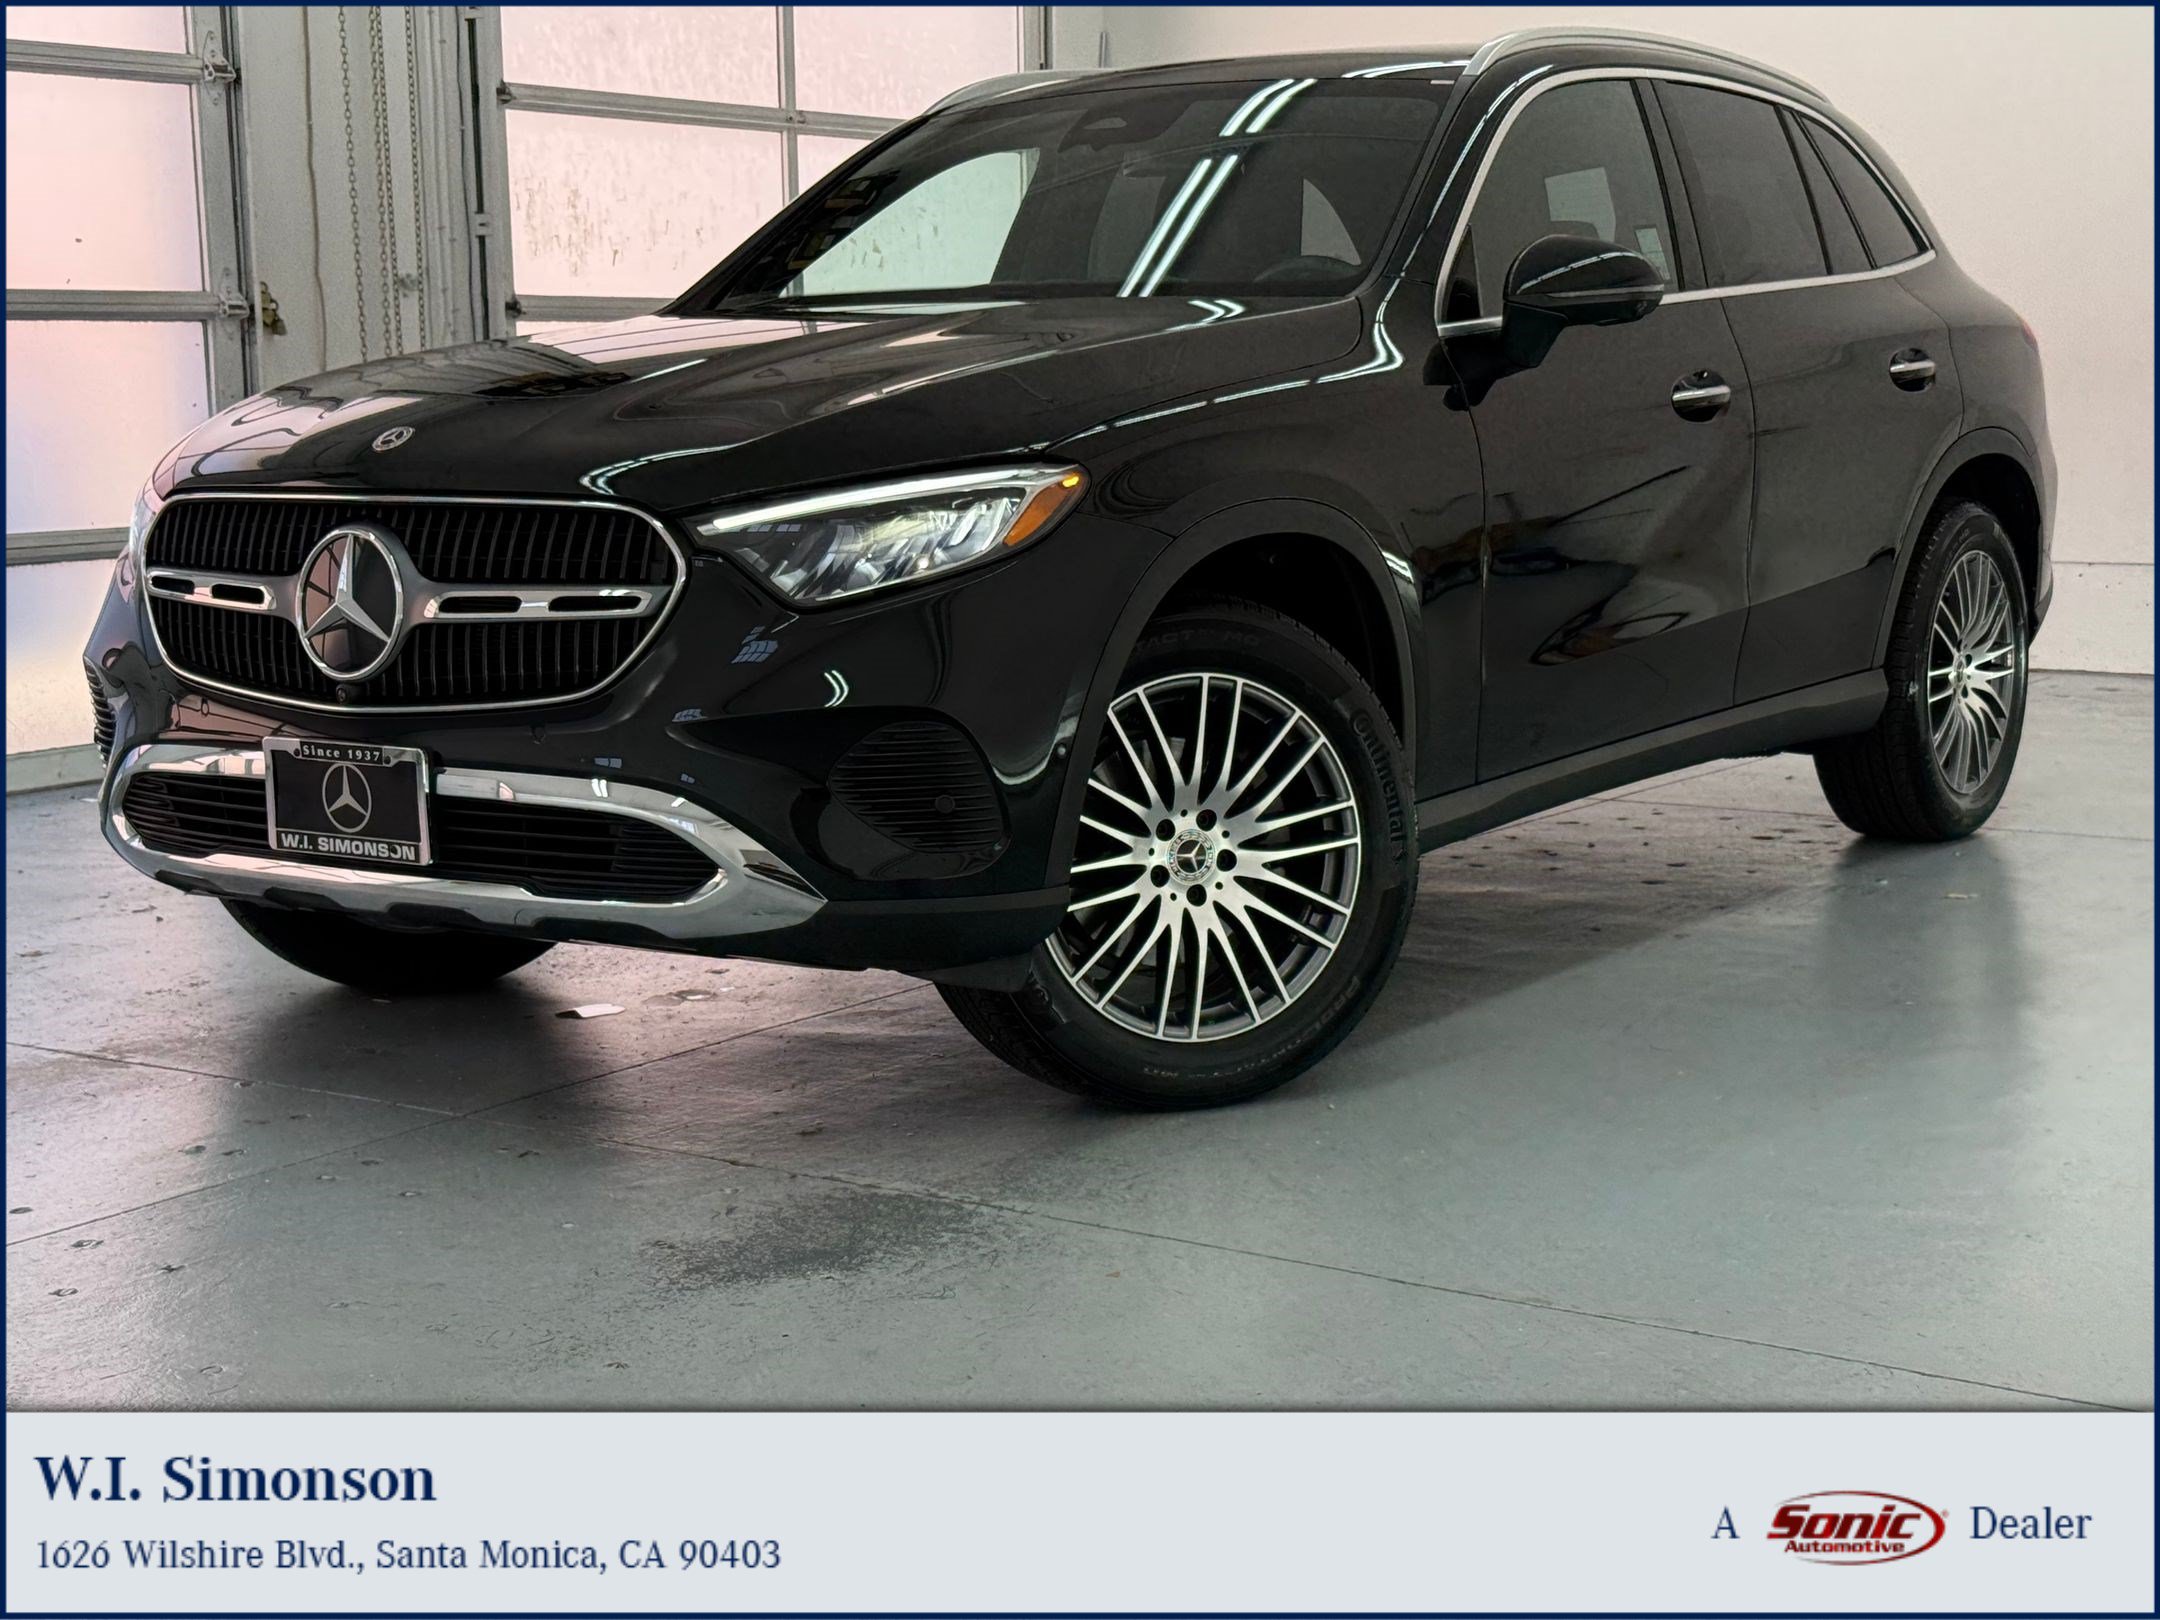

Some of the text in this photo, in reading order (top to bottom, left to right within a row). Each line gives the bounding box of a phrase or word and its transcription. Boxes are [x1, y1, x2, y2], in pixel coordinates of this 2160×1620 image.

[302, 744, 382, 762] Since 1937
[281, 832, 416, 861] W.I. SIMONSON
